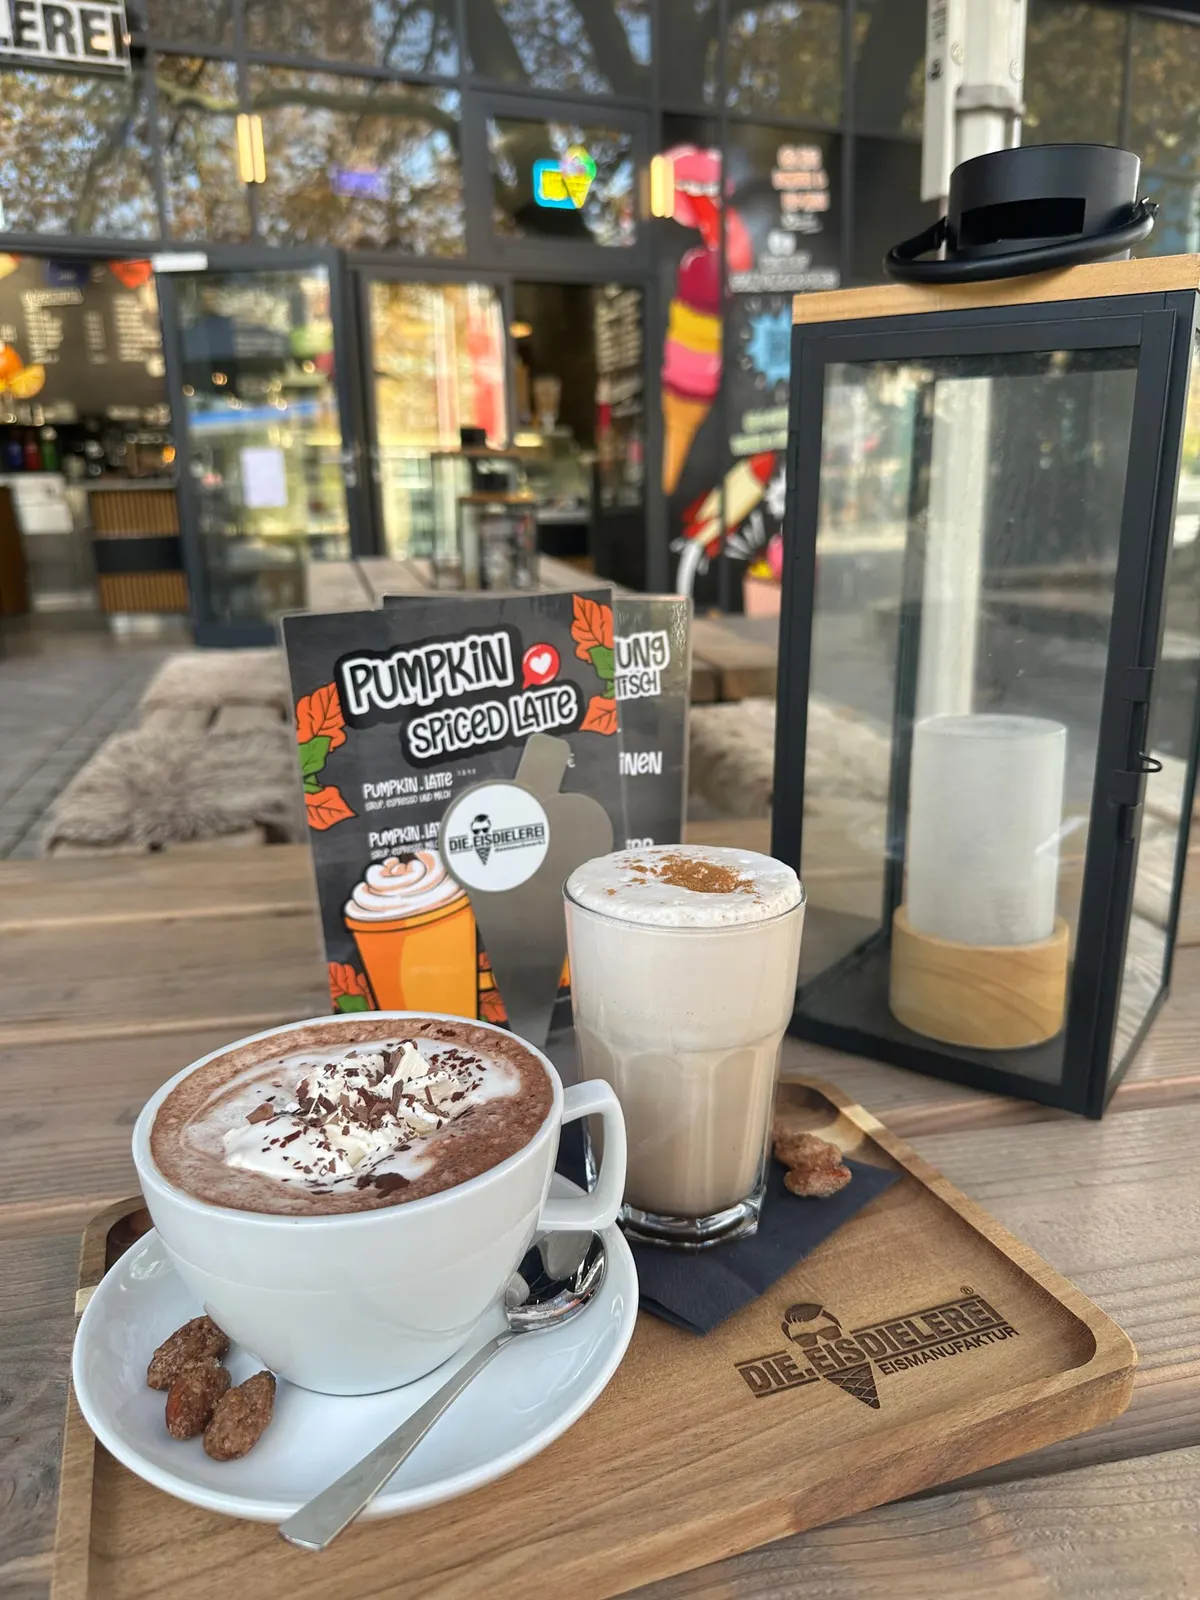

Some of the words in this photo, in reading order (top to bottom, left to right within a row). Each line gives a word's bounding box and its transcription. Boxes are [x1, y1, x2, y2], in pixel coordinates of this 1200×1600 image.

[0, 1, 124, 58] EREI
[615, 633, 668, 669] UNg
[619, 751, 662, 775] iNeN
[878, 1326, 1020, 1376] EISMANUFAKTUR
